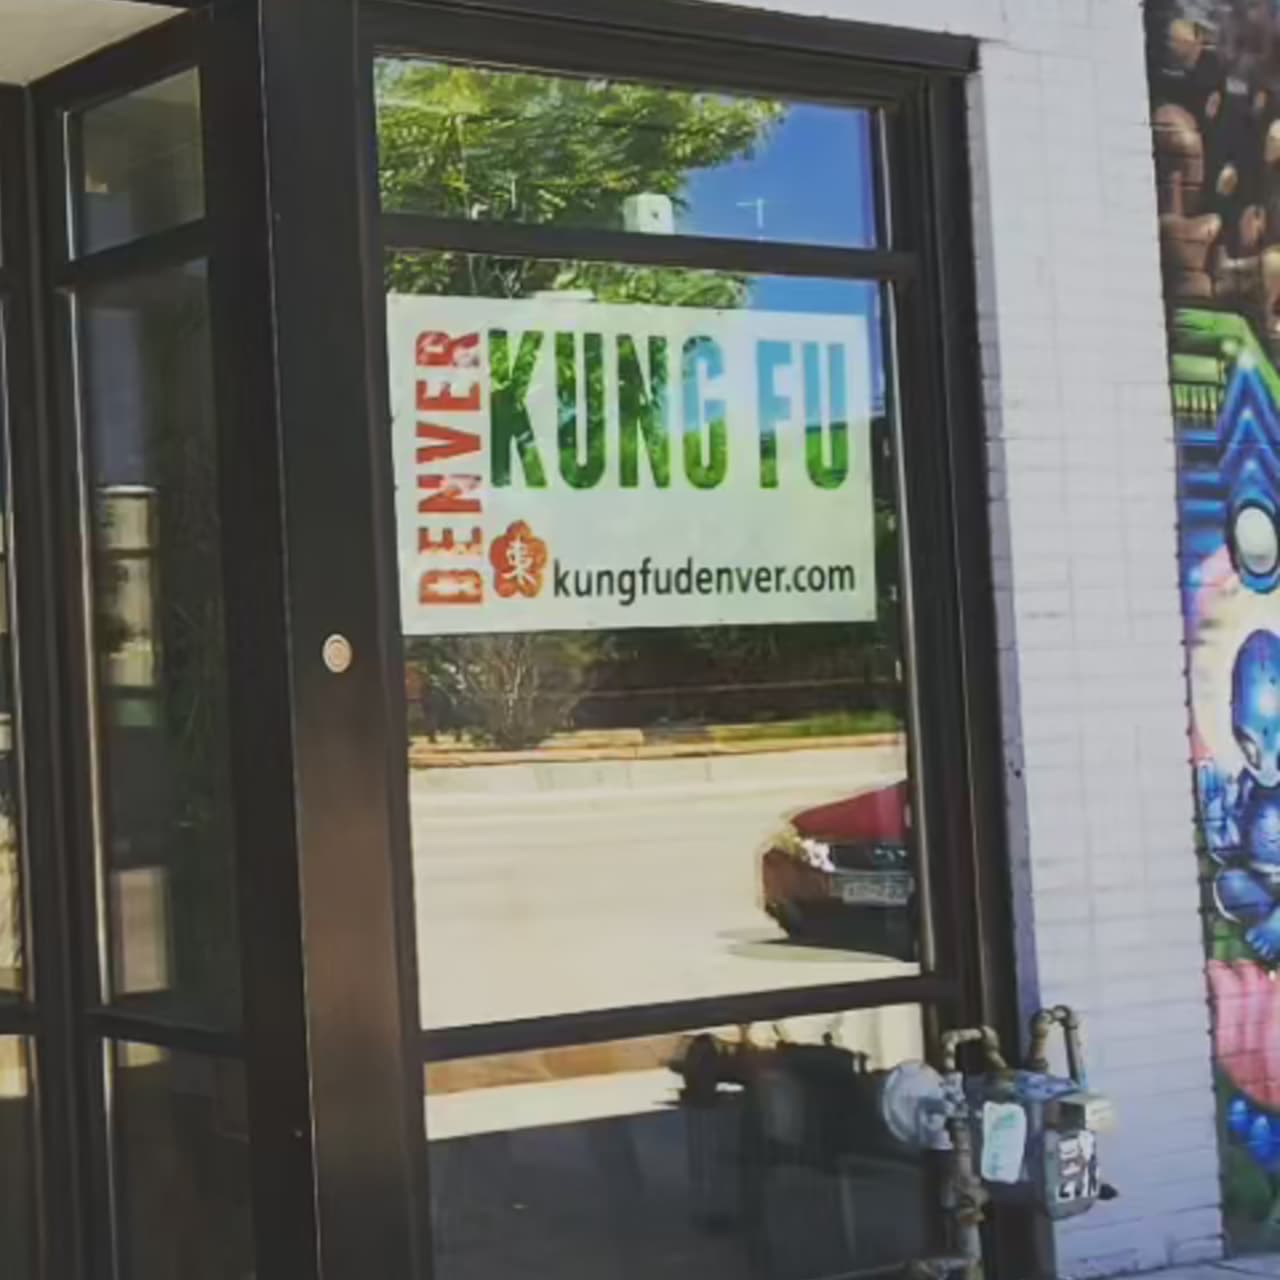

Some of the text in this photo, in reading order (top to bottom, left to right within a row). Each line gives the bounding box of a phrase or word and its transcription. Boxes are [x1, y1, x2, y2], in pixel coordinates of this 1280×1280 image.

[415, 330, 482, 605] DENVER
[487, 329, 849, 489] KUNG FU
[553, 557, 856, 606] kungfudenver.com
